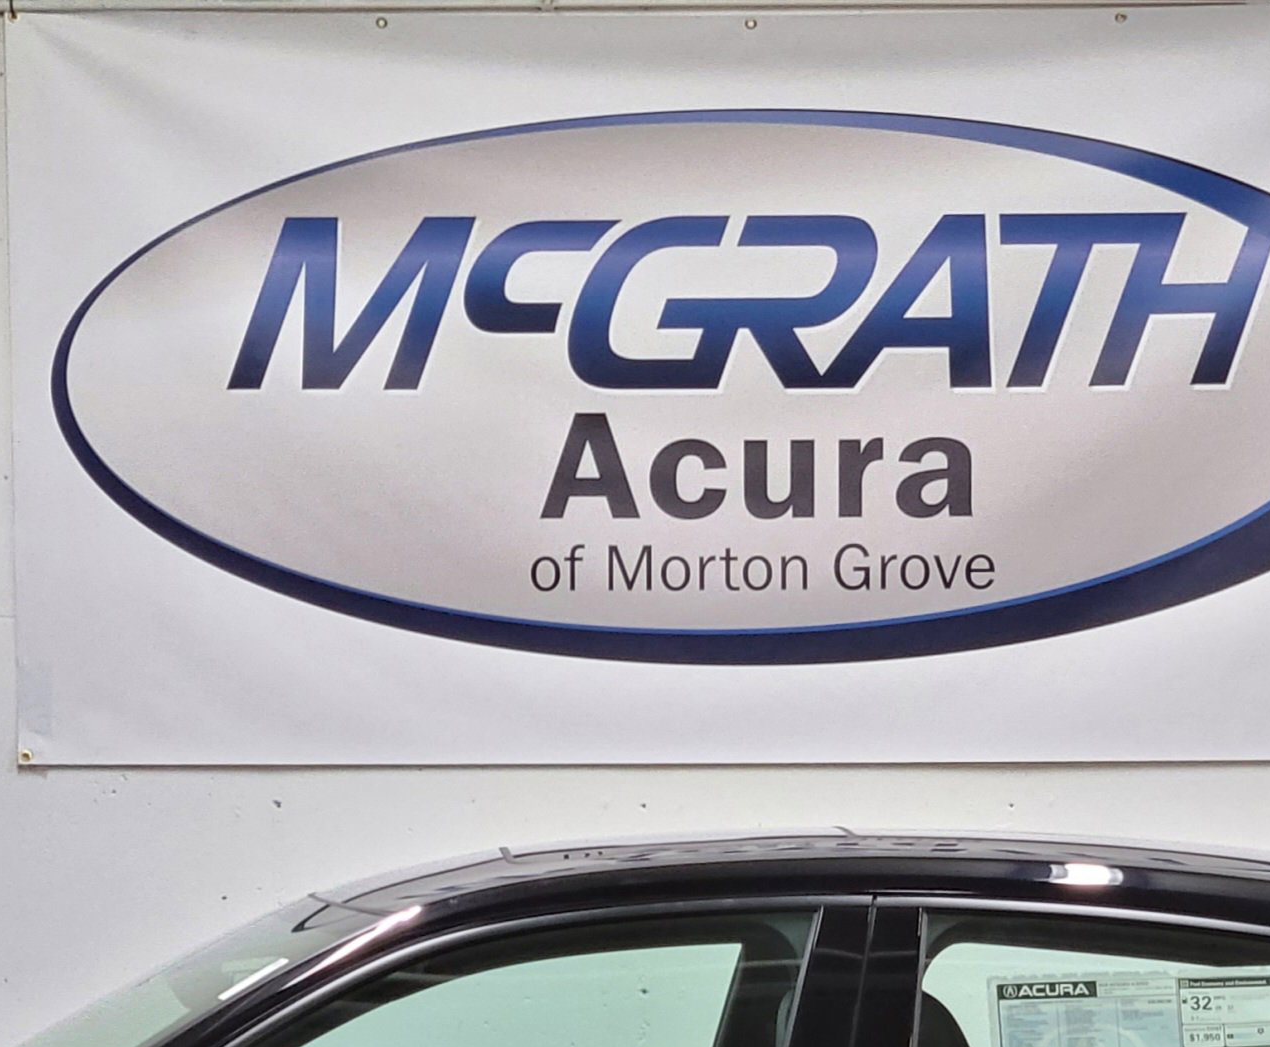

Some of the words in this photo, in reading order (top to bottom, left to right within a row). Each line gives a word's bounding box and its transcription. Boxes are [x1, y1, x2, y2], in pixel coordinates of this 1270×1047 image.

[540, 412, 974, 520] Acura
[529, 544, 586, 592] of
[608, 545, 809, 592] Morton
[833, 543, 997, 591] Grove
[1018, 983, 1090, 998] ACURA
[1190, 995, 1213, 1011] 32
